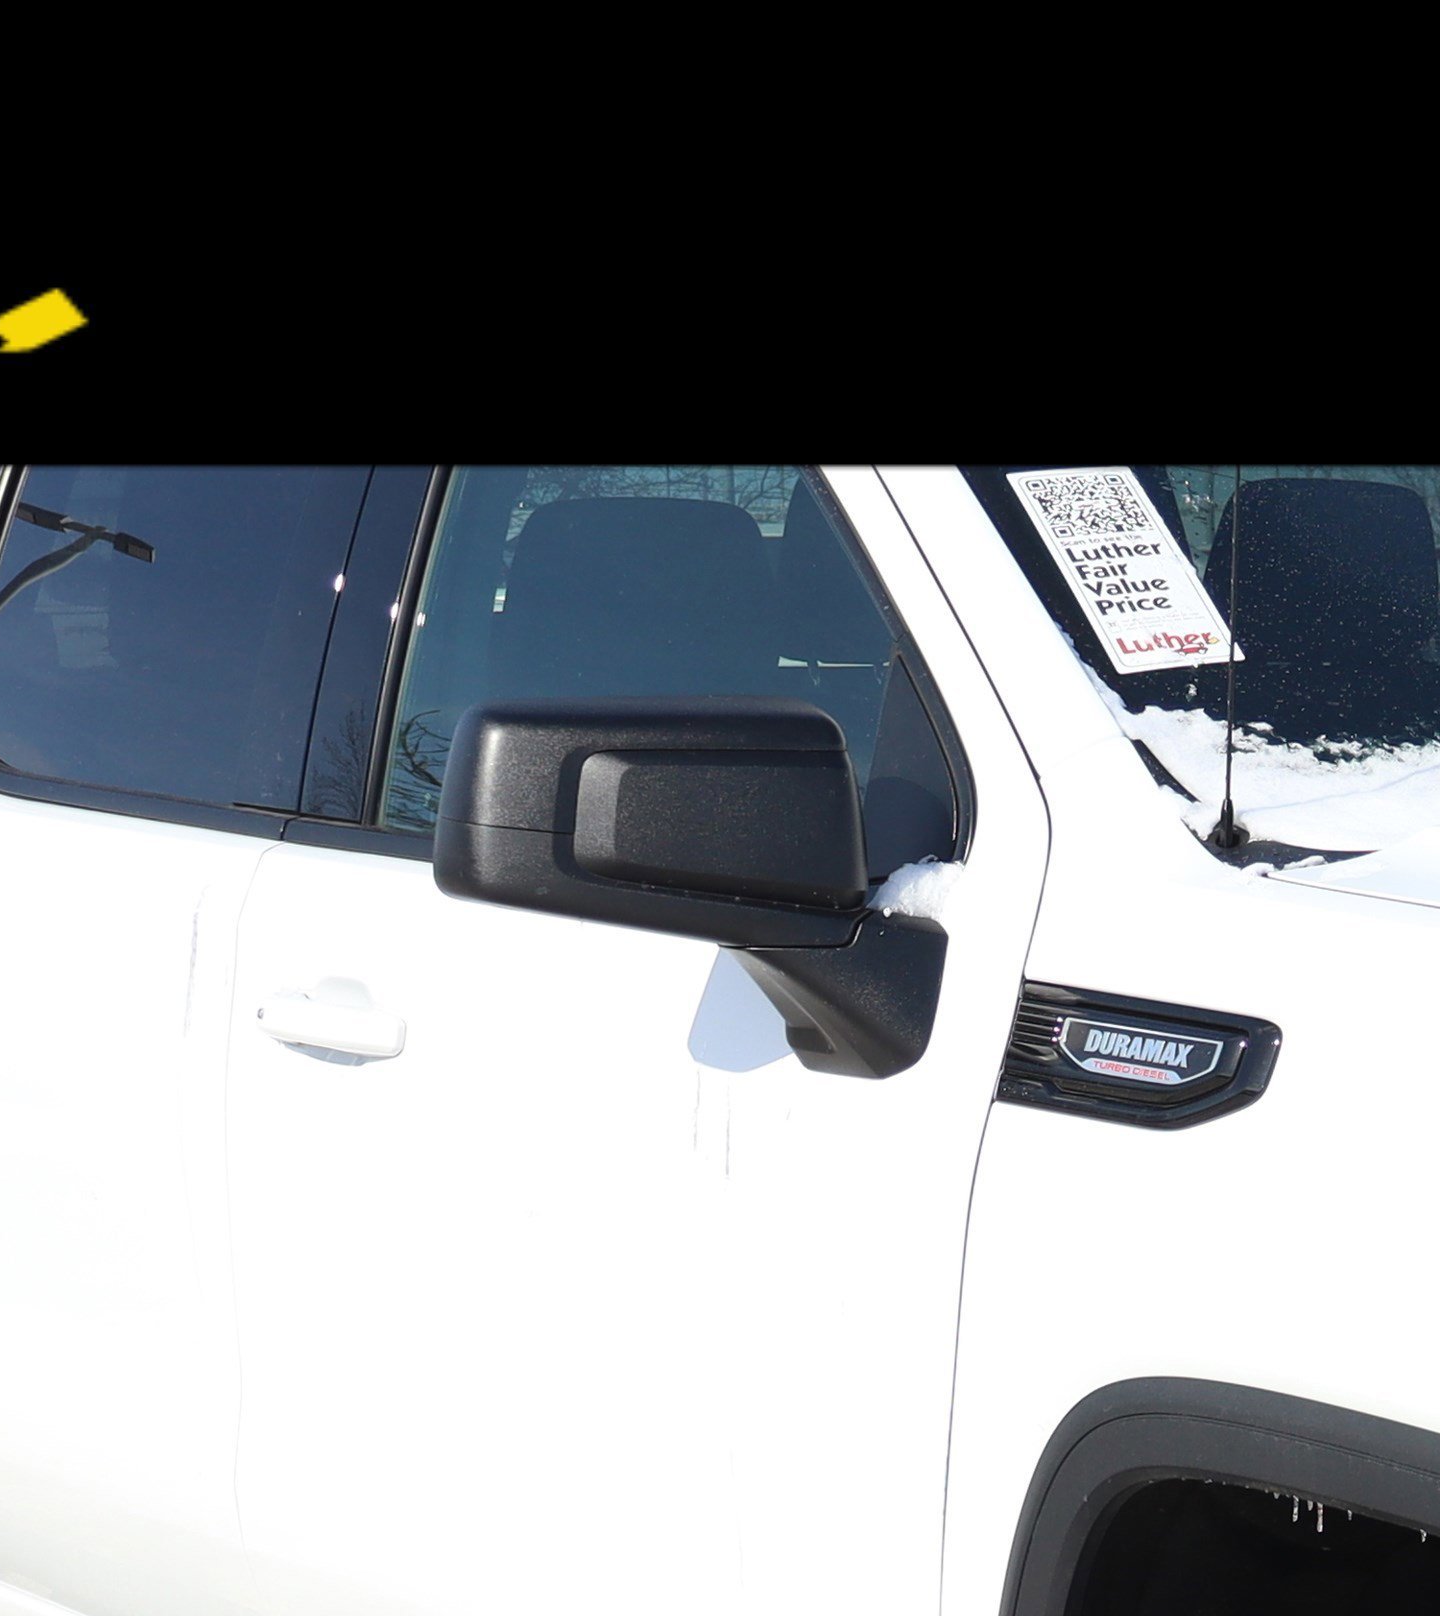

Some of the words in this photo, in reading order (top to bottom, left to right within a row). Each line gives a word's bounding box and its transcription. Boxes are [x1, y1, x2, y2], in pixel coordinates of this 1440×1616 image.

[1065, 542, 1162, 563] Luther
[1075, 560, 1128, 580] Fair
[1083, 578, 1170, 597] Value
[1095, 596, 1172, 616] Price
[1115, 631, 1212, 655] Luther
[1083, 1028, 1194, 1069] DURAMAX
[1092, 1059, 1131, 1074] TURBO
[1132, 1065, 1172, 1081] DIESEL
